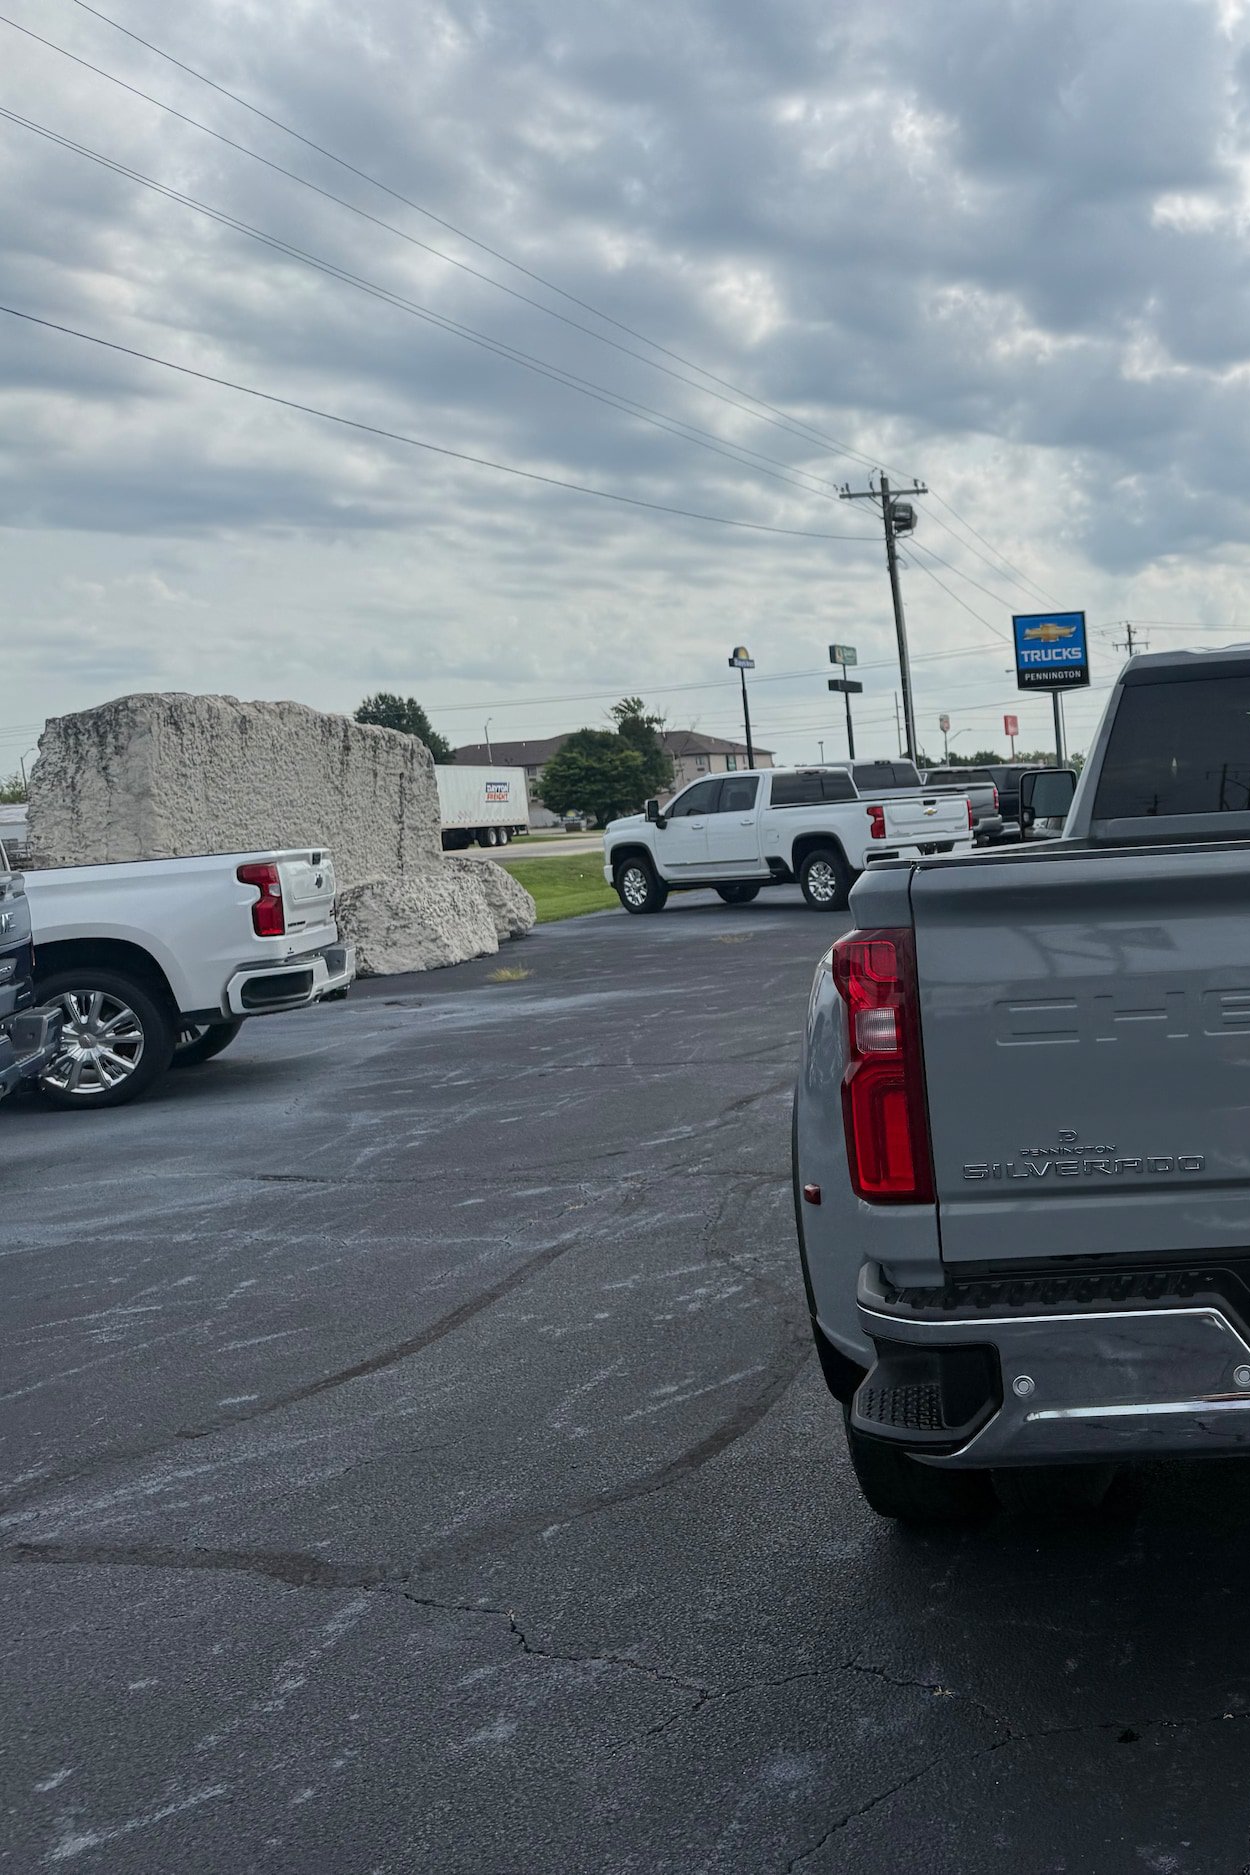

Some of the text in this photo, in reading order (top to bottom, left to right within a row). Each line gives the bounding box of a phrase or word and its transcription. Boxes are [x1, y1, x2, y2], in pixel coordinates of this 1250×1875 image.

[1020, 647, 1082, 662] TRUCKS
[1024, 670, 1081, 681] PENNINGTON
[1020, 1144, 1117, 1157] PENNINGTON
[963, 1155, 1206, 1180] SILVERADO
